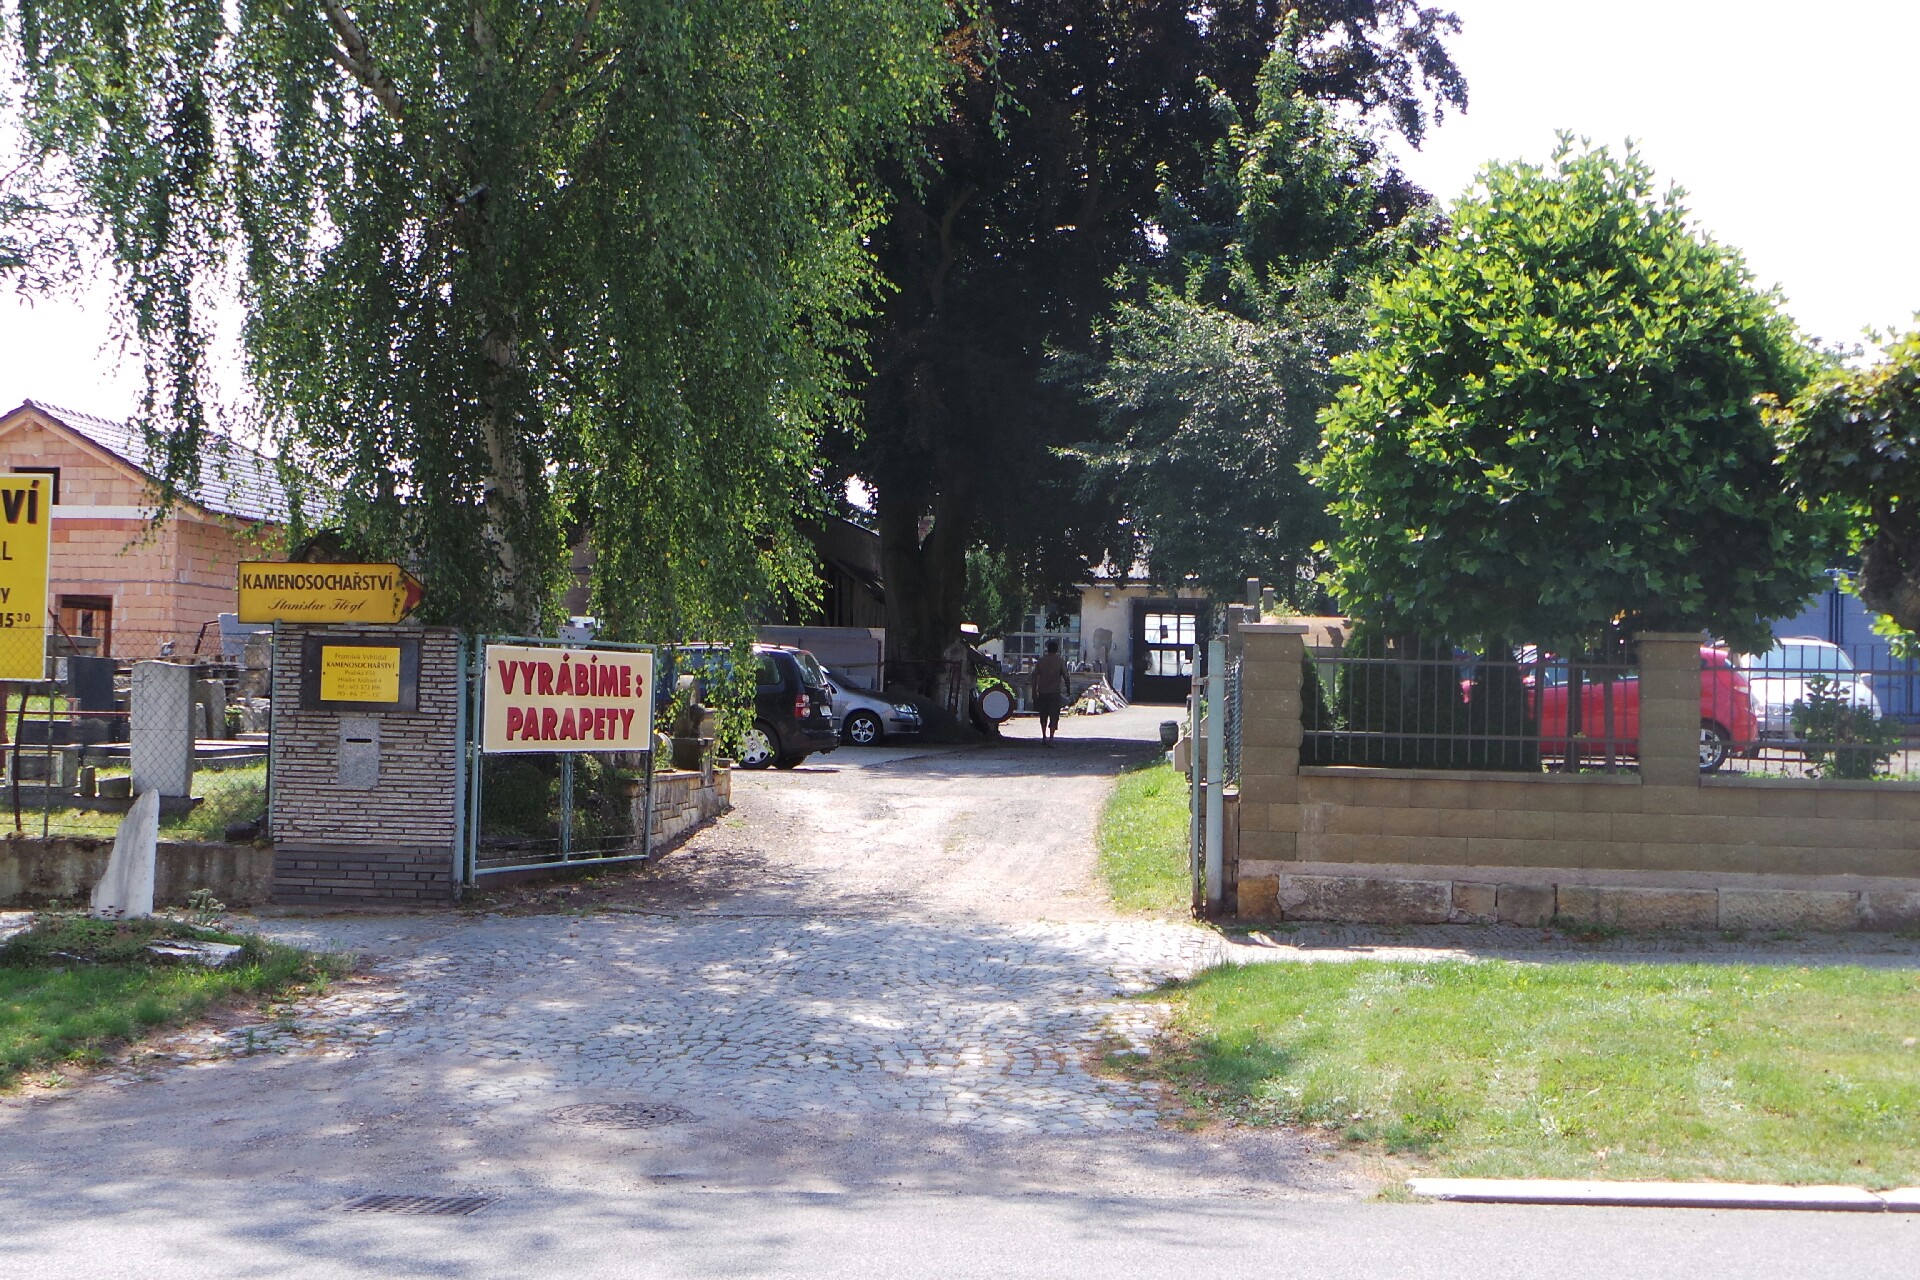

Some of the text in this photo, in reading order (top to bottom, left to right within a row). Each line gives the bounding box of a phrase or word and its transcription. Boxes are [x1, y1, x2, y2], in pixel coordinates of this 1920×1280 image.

[0, 540, 13, 561] L
[242, 571, 393, 591] KAMENOSOCHAŘSTVÍ
[268, 598, 326, 611] Stanislav
[326, 661, 396, 669] KAMENOSOCHAŘSTVÍ
[498, 652, 643, 698] VYRÁBÍME:
[506, 706, 635, 741] PARAPETY
